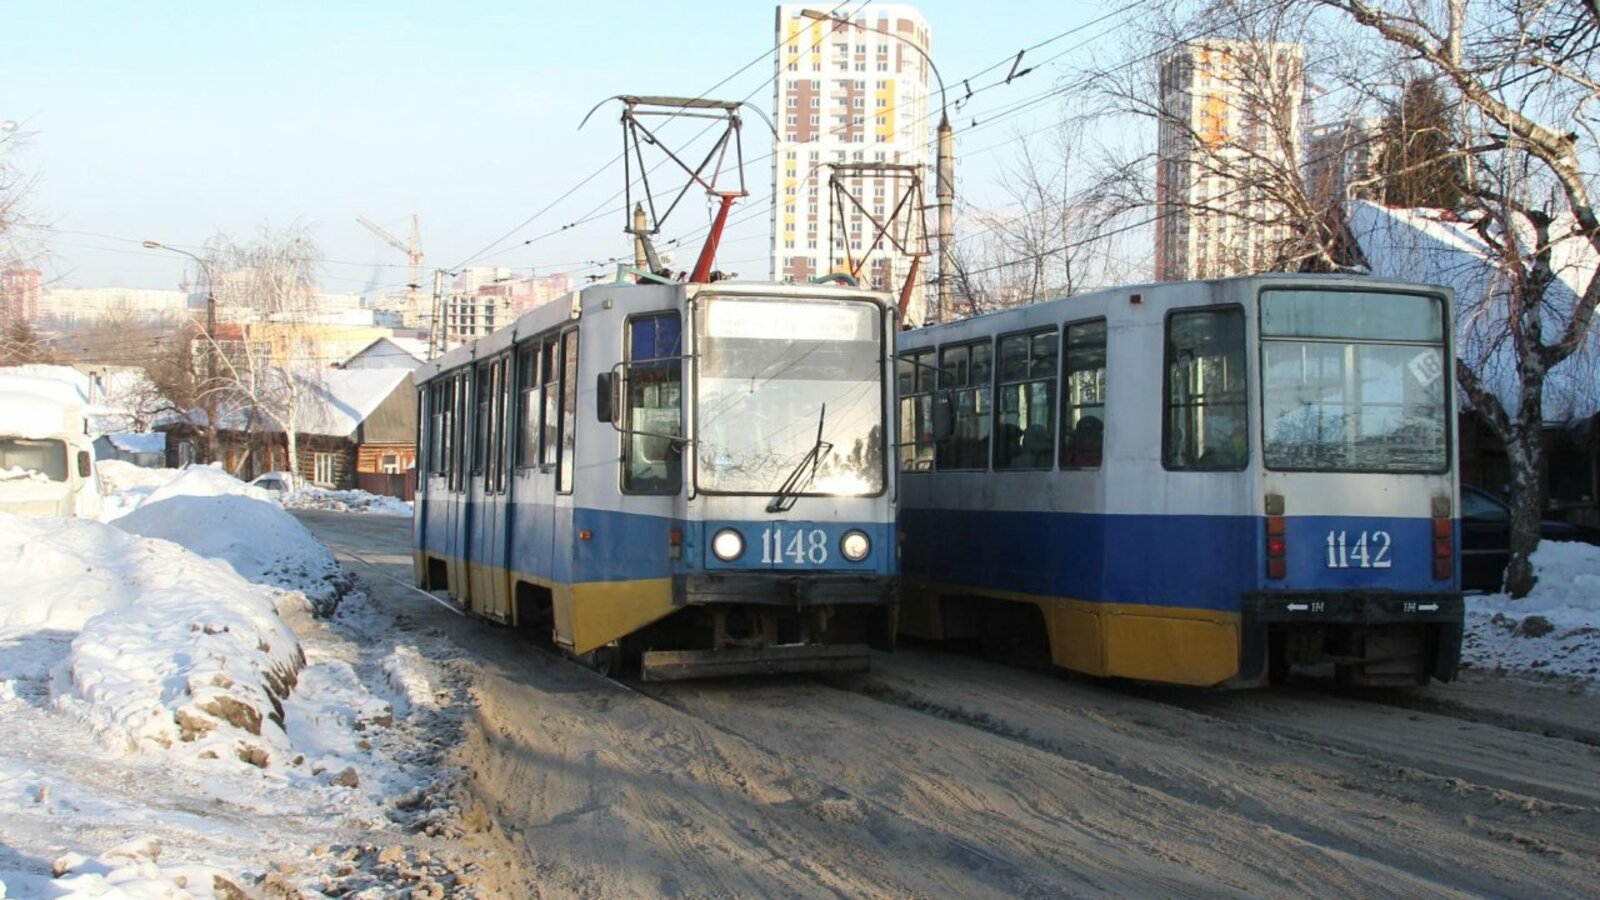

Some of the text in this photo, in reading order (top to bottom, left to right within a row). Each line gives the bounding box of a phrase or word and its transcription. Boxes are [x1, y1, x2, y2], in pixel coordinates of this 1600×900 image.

[1417, 353, 1440, 379] 18
[761, 528, 828, 564] 1148
[1326, 530, 1392, 568] 1142
